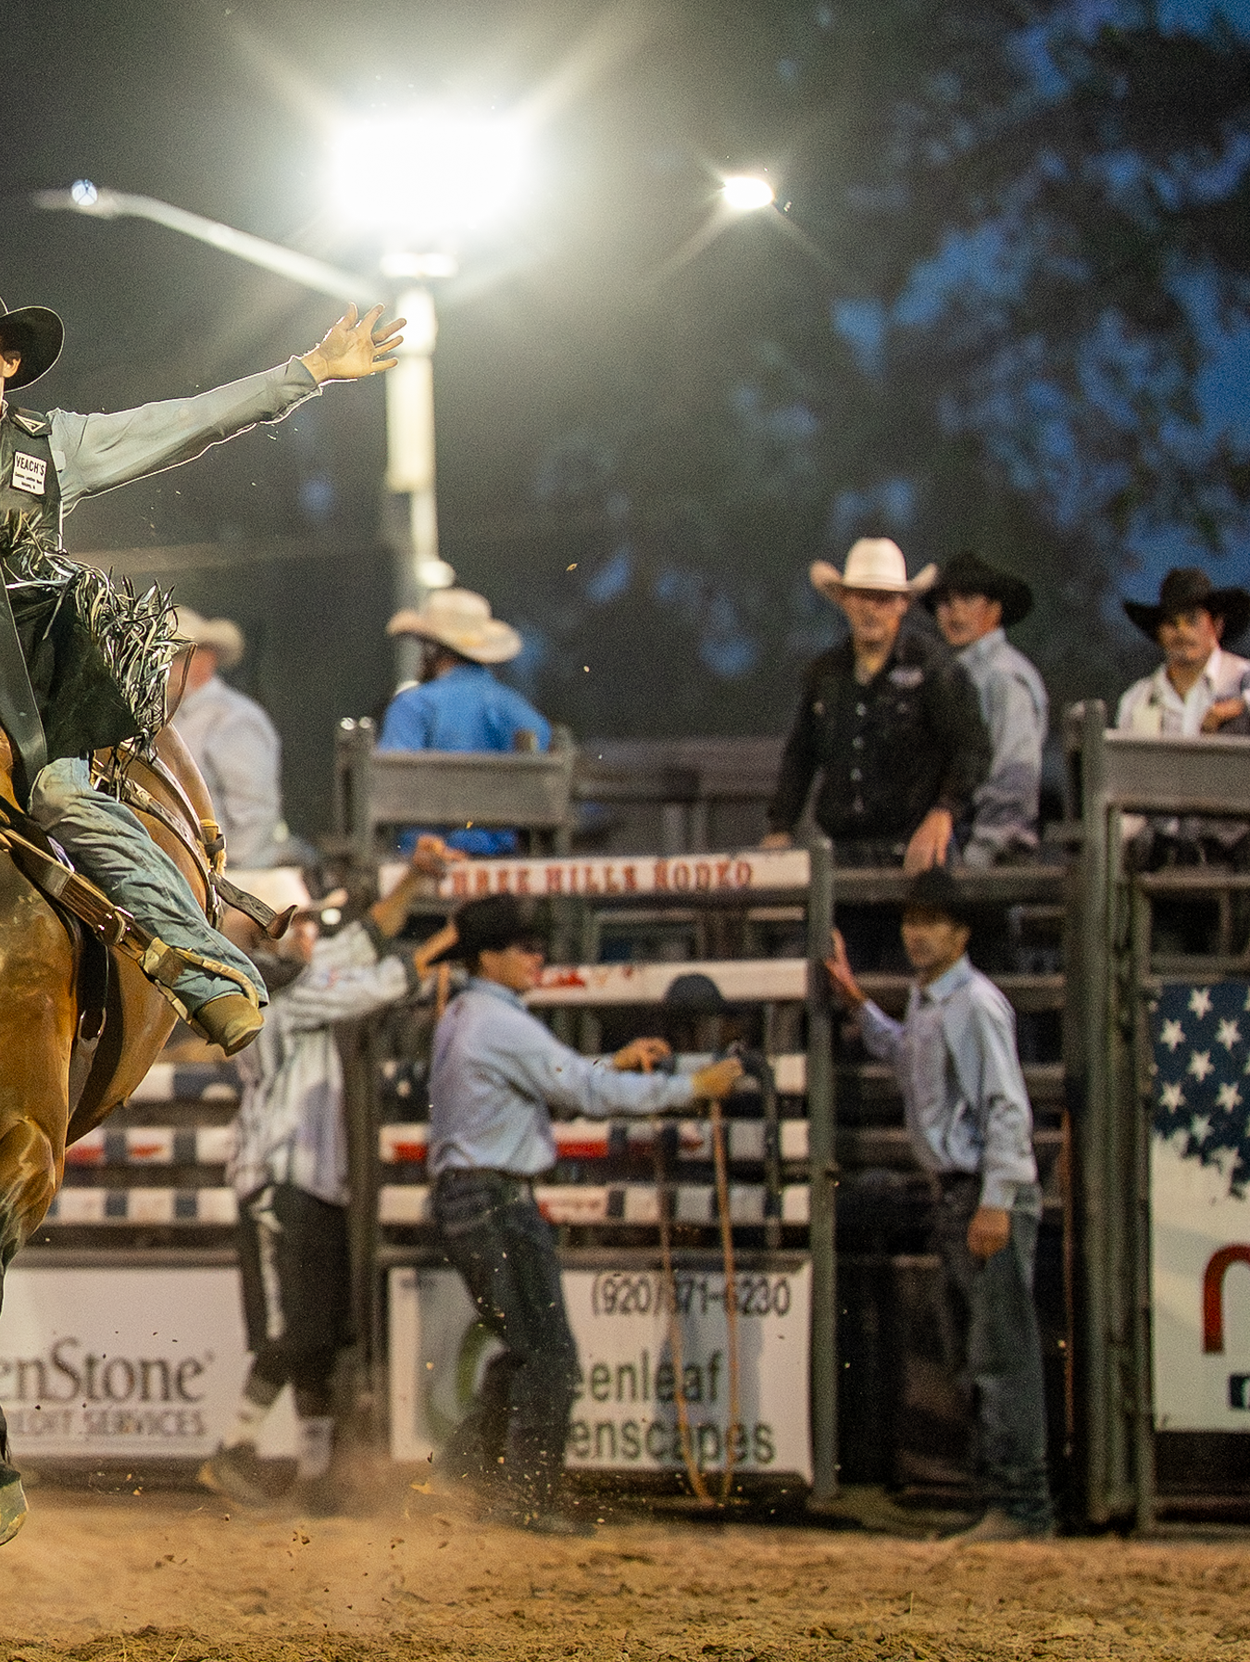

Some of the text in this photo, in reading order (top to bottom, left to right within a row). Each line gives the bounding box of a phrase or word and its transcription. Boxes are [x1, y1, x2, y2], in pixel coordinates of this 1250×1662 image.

[16, 455, 45, 476] VEACH'S
[450, 866, 530, 898] HREE
[591, 1274, 792, 1317] (920)71-230
[574, 1348, 721, 1402] enleaf
[567, 1417, 776, 1471] enscapes
